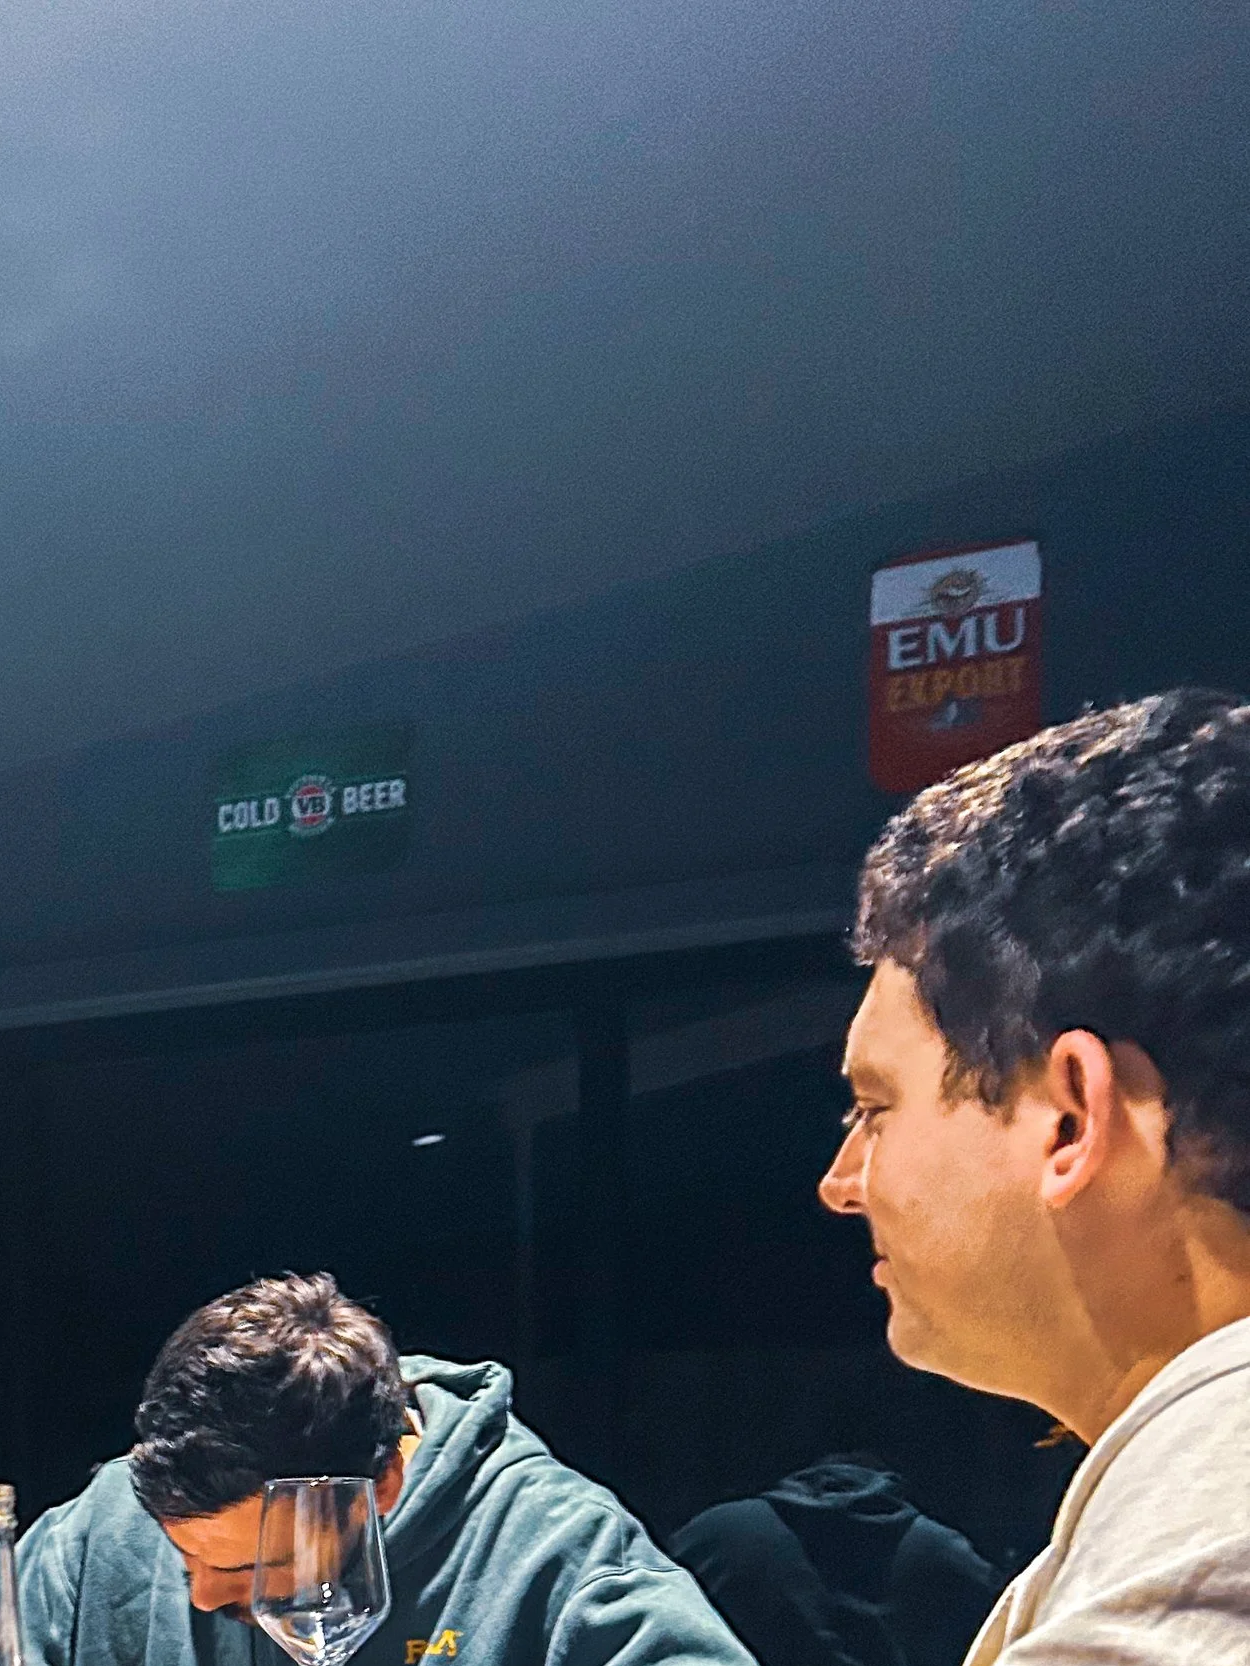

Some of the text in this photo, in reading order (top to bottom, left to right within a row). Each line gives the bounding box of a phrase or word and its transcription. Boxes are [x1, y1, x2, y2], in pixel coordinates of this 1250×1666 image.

[887, 606, 1026, 672] EMU
[218, 797, 280, 833] COLD
[343, 778, 407, 815] BEER
